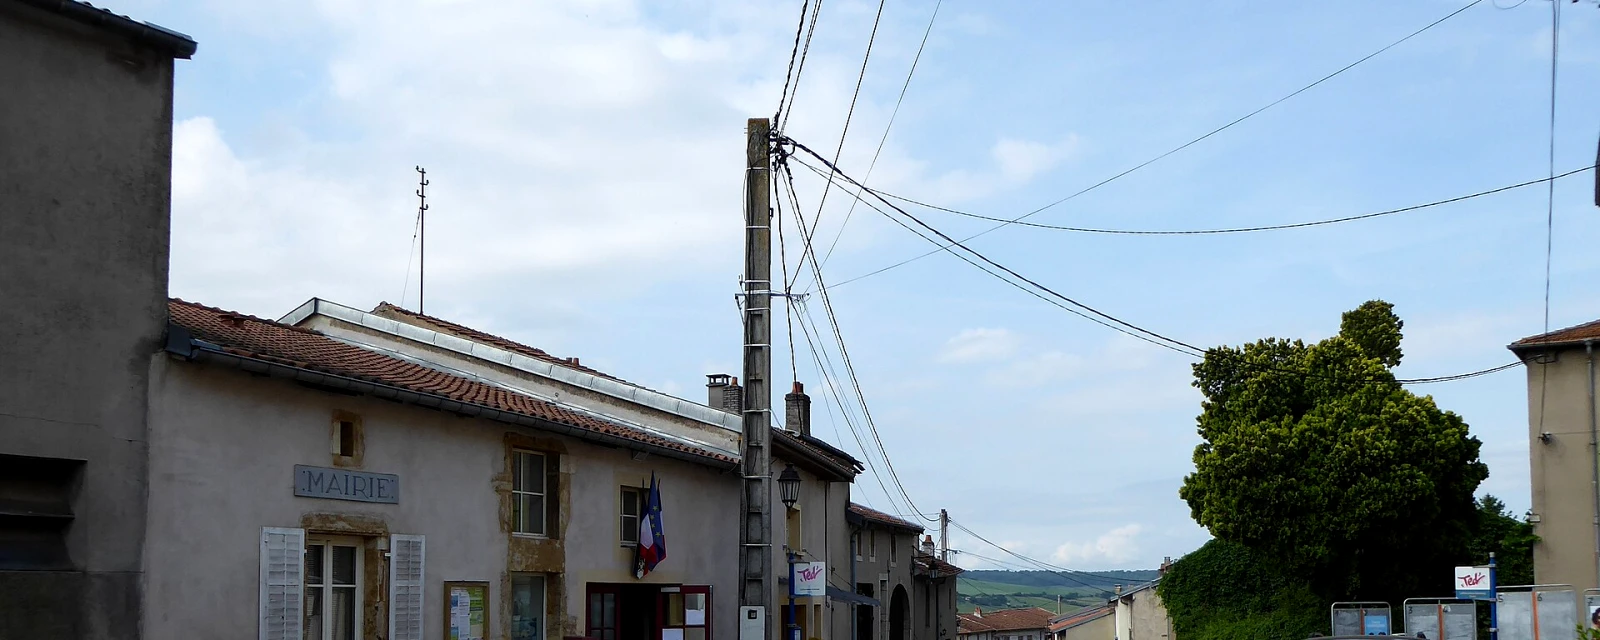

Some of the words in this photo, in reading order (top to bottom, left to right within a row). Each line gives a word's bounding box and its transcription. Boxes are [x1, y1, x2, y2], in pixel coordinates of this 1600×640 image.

[307, 471, 390, 499] MAIRIE
[1497, 594, 1504, 603] 5
[1537, 593, 1543, 602] 6
[1408, 606, 1413, 615] 3
